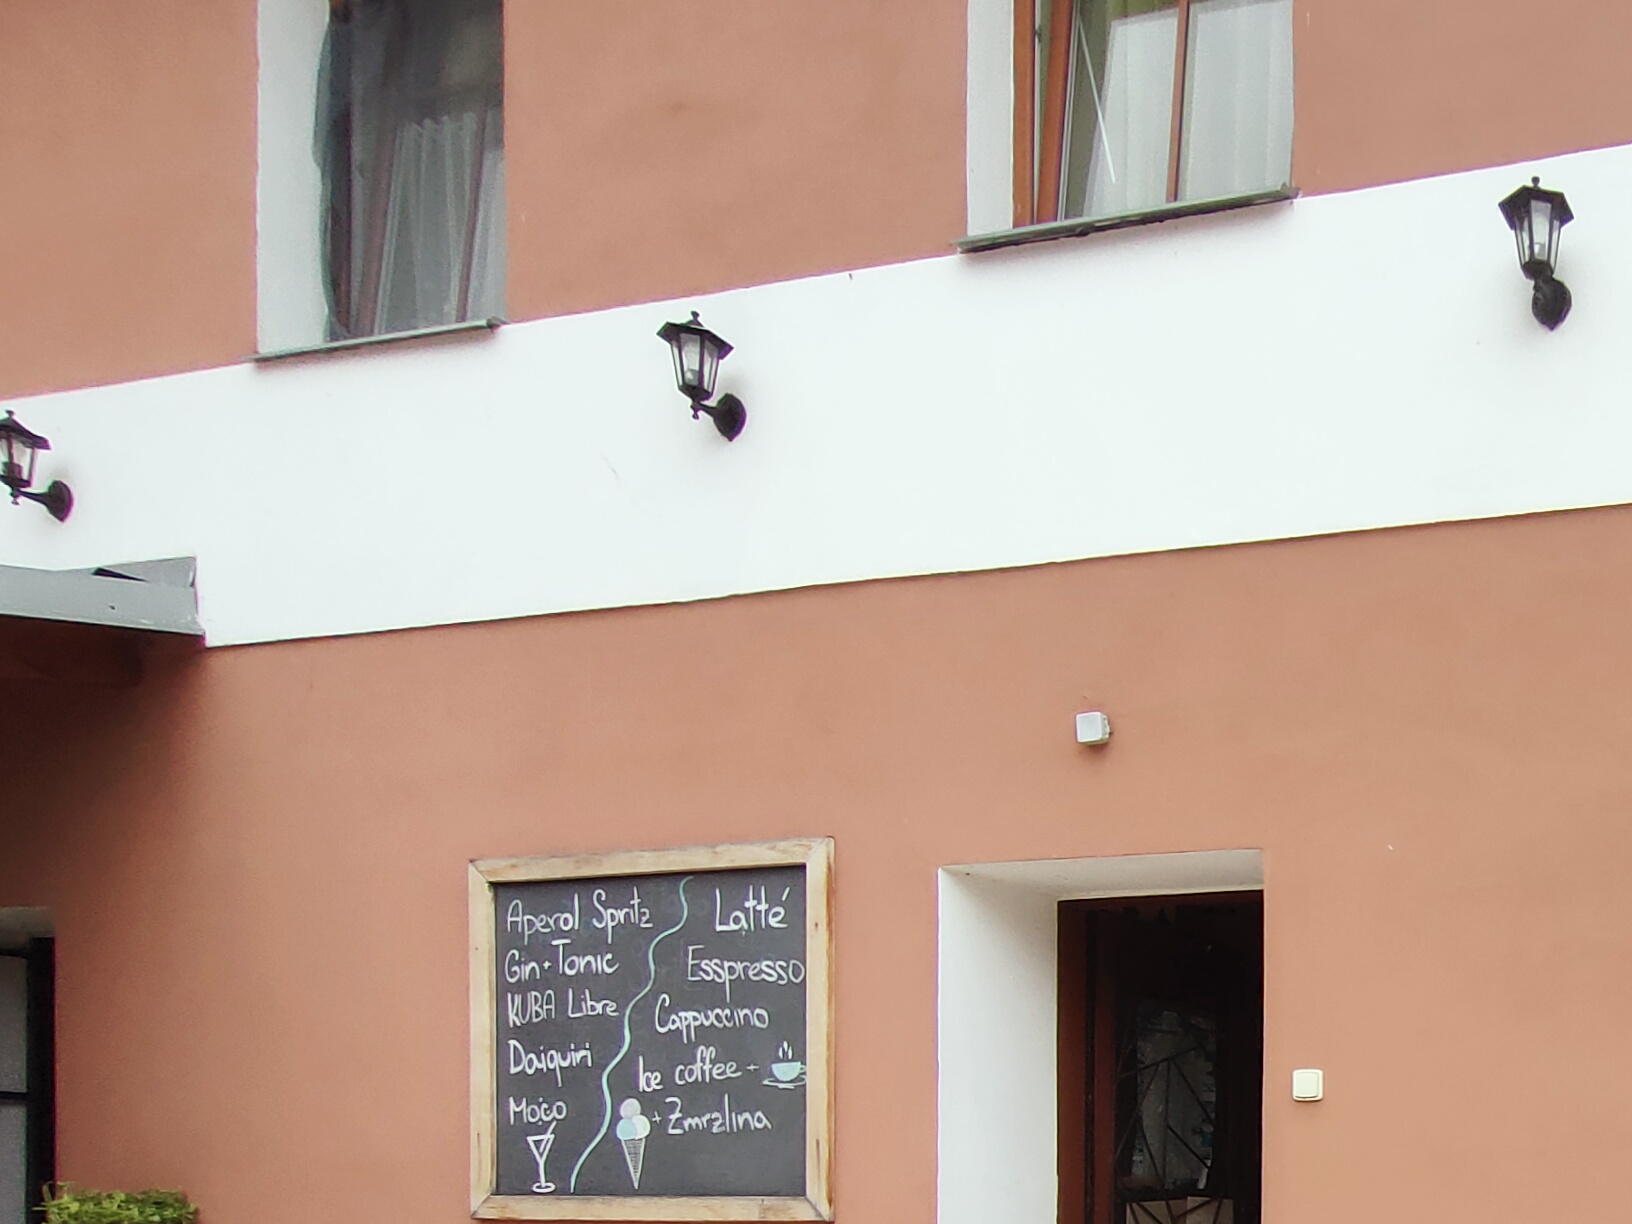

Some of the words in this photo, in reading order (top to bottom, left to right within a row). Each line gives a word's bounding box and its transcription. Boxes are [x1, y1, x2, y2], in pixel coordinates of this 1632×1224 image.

[507, 892, 579, 946] Aperol
[592, 886, 653, 944] Spritz
[715, 884, 791, 933] Latté
[687, 945, 805, 1004] Esspresso
[507, 989, 555, 1028] KUBA
[568, 987, 620, 1018] Libre
[655, 993, 769, 1044] Cappuccino
[507, 1039, 592, 1088] Daiquiri
[638, 1055, 664, 1092] Ice
[674, 1045, 743, 1085] coffee
[665, 1092, 772, 1134] Zmrzlina
